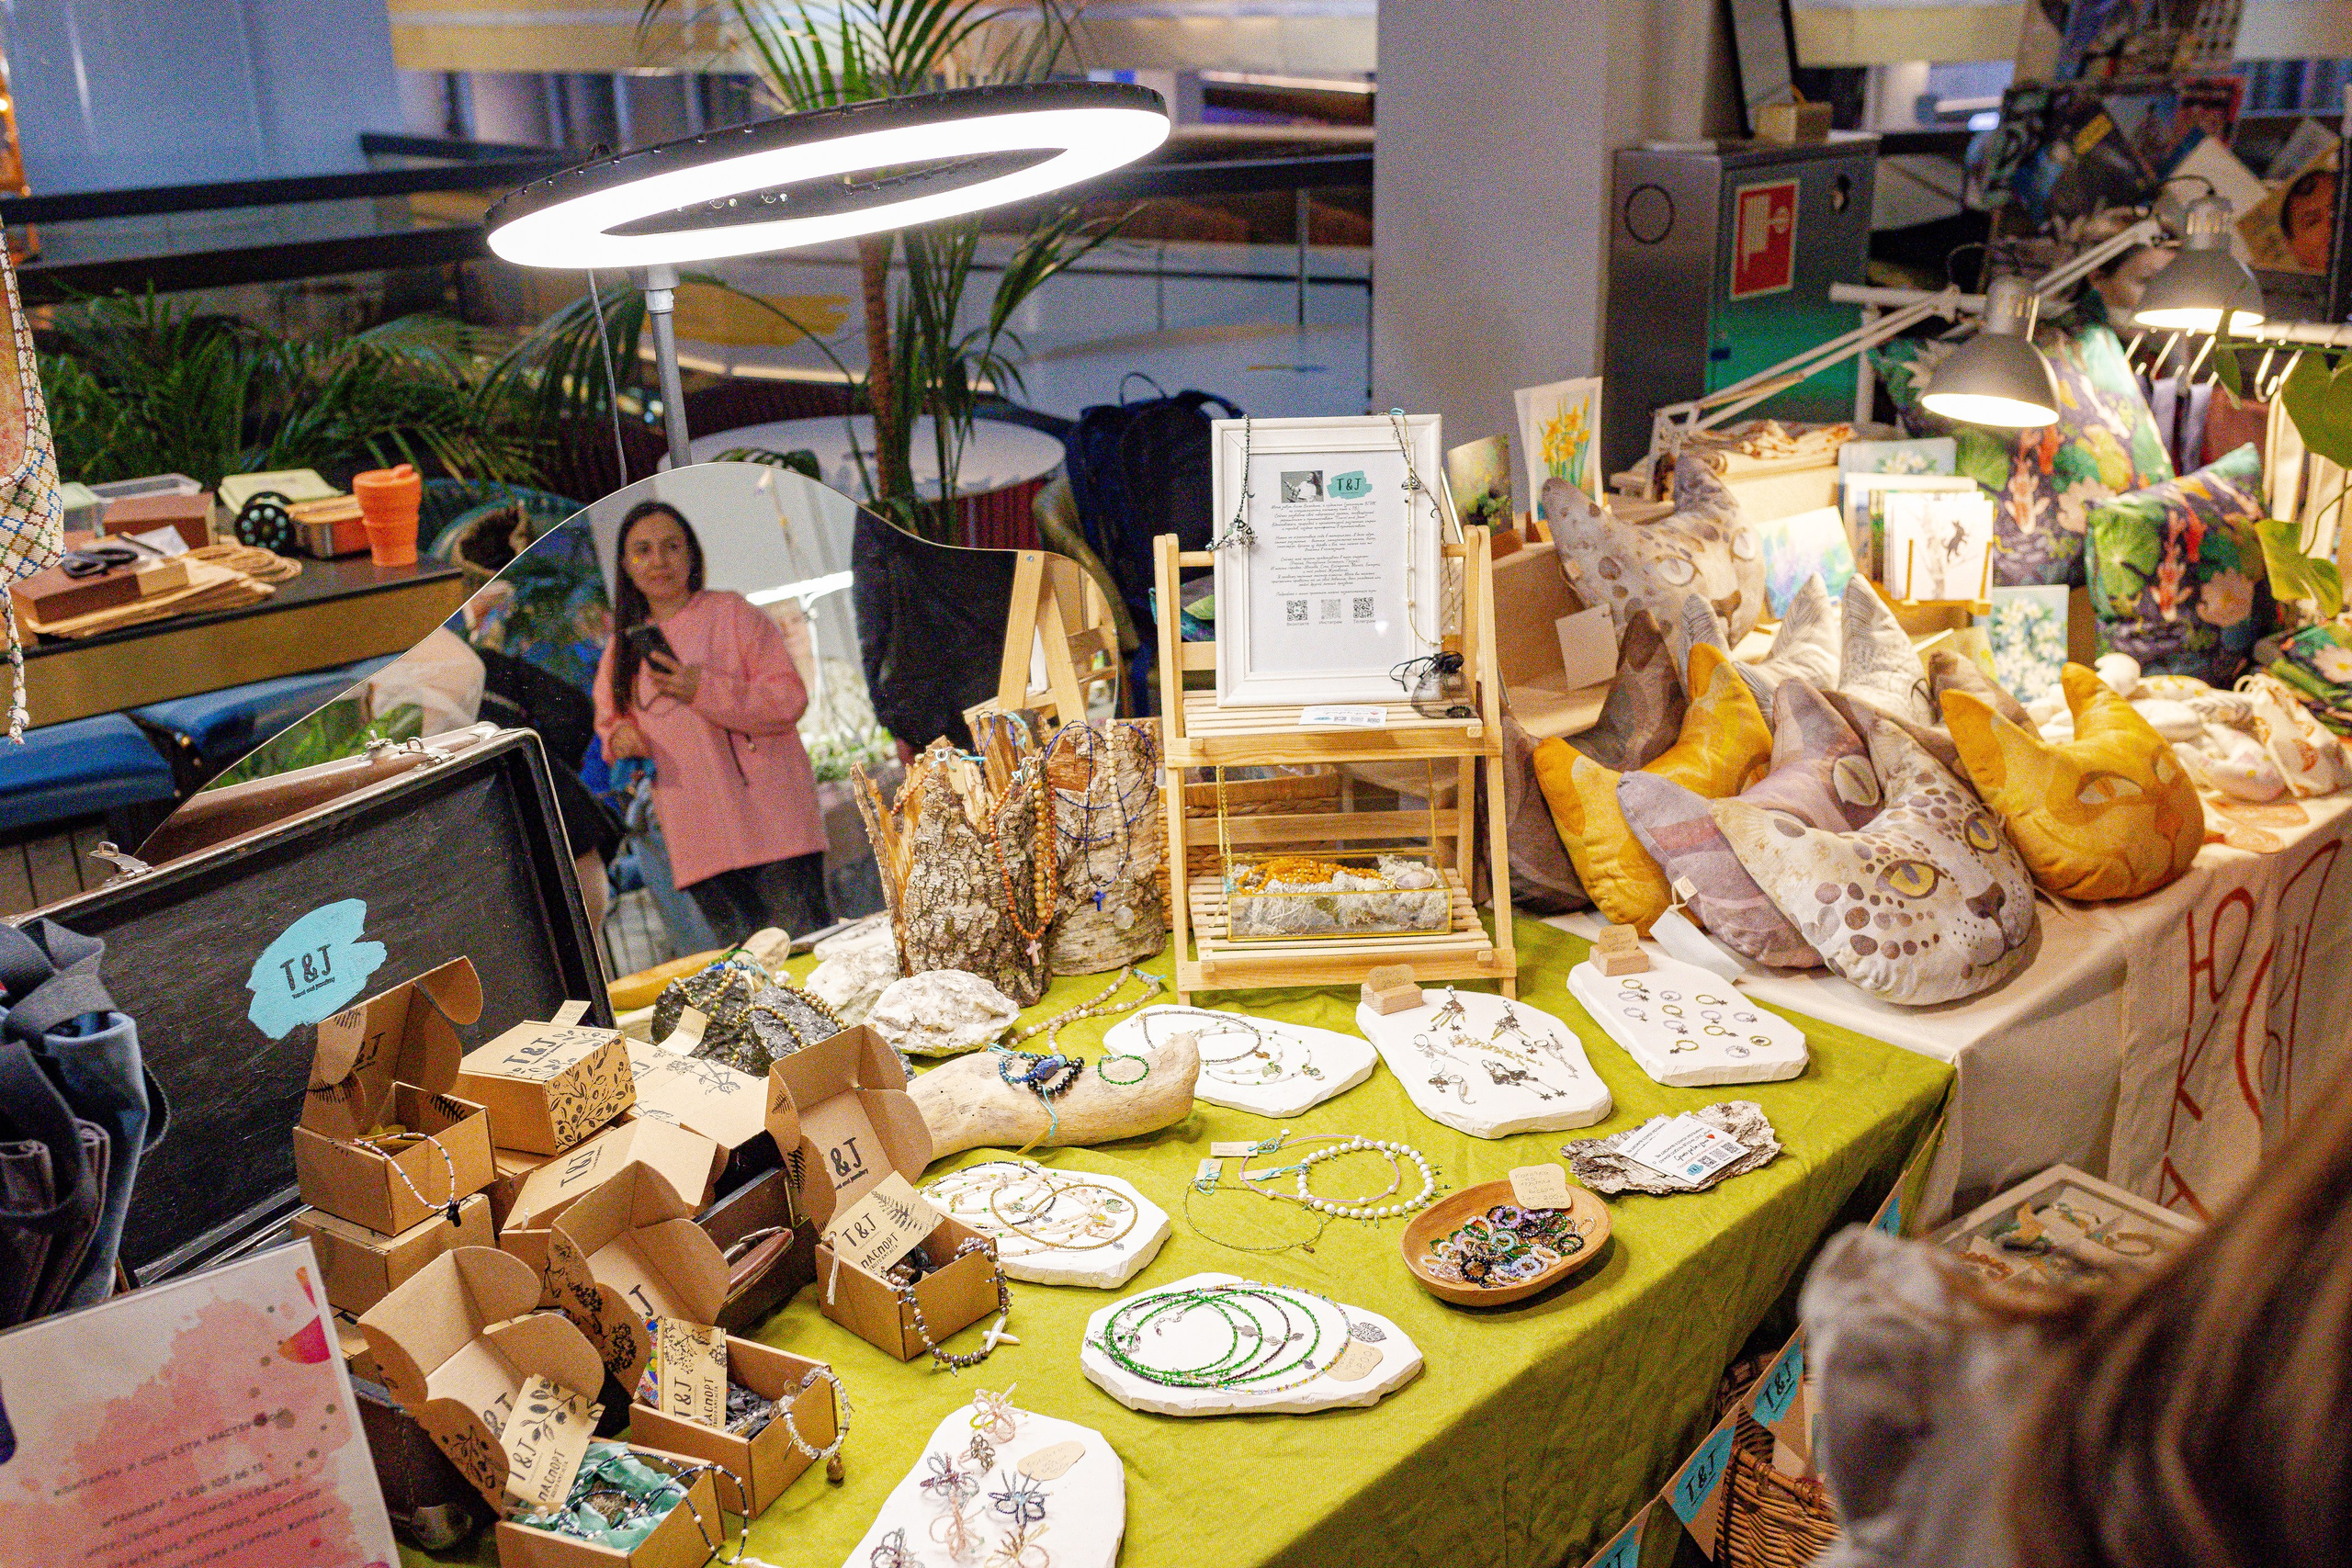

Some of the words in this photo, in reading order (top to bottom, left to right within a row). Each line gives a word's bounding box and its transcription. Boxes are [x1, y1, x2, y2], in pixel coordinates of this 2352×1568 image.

[279, 943, 332, 991] T&J
[842, 1213, 876, 1247] T&J
[860, 1232, 899, 1269] ПАСПОРТ
[1762, 1356, 1792, 1410] T&J
[1685, 1447, 1717, 1504] T&J
